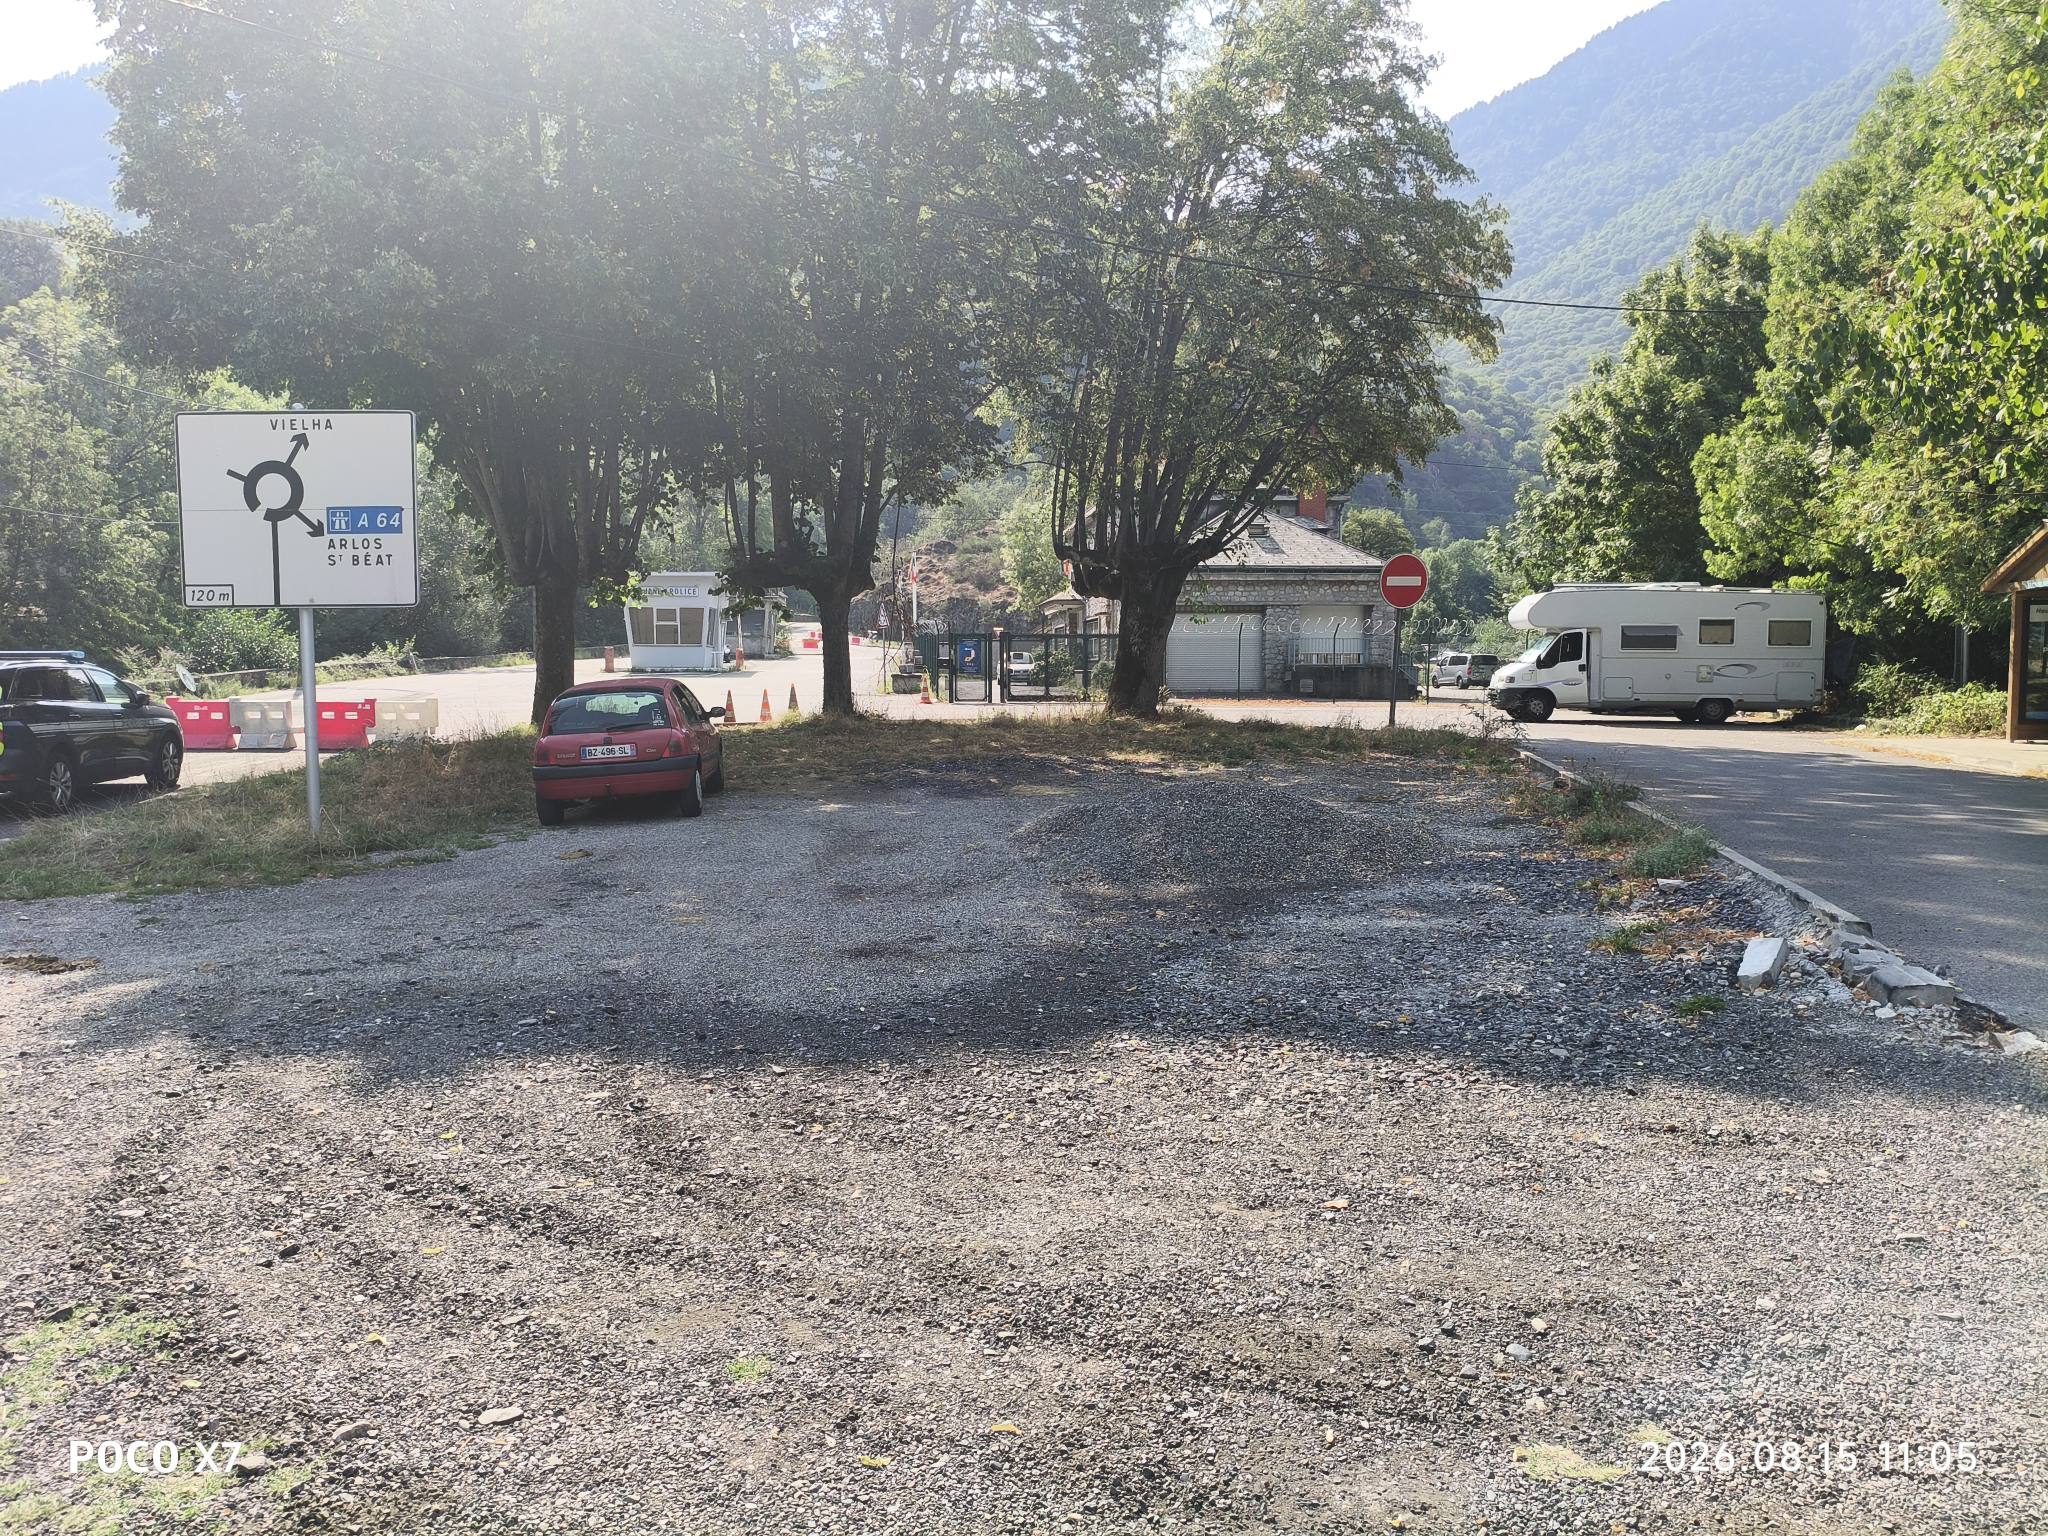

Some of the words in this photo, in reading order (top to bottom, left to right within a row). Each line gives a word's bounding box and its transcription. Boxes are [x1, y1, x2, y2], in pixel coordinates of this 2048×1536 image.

[270, 418, 333, 431] VIELHA
[357, 512, 369, 528] A
[376, 512, 401, 528] 64
[327, 537, 383, 550] ARLOS
[351, 551, 393, 566] BÉAT
[191, 589, 215, 602] 120
[218, 592, 230, 601] m
